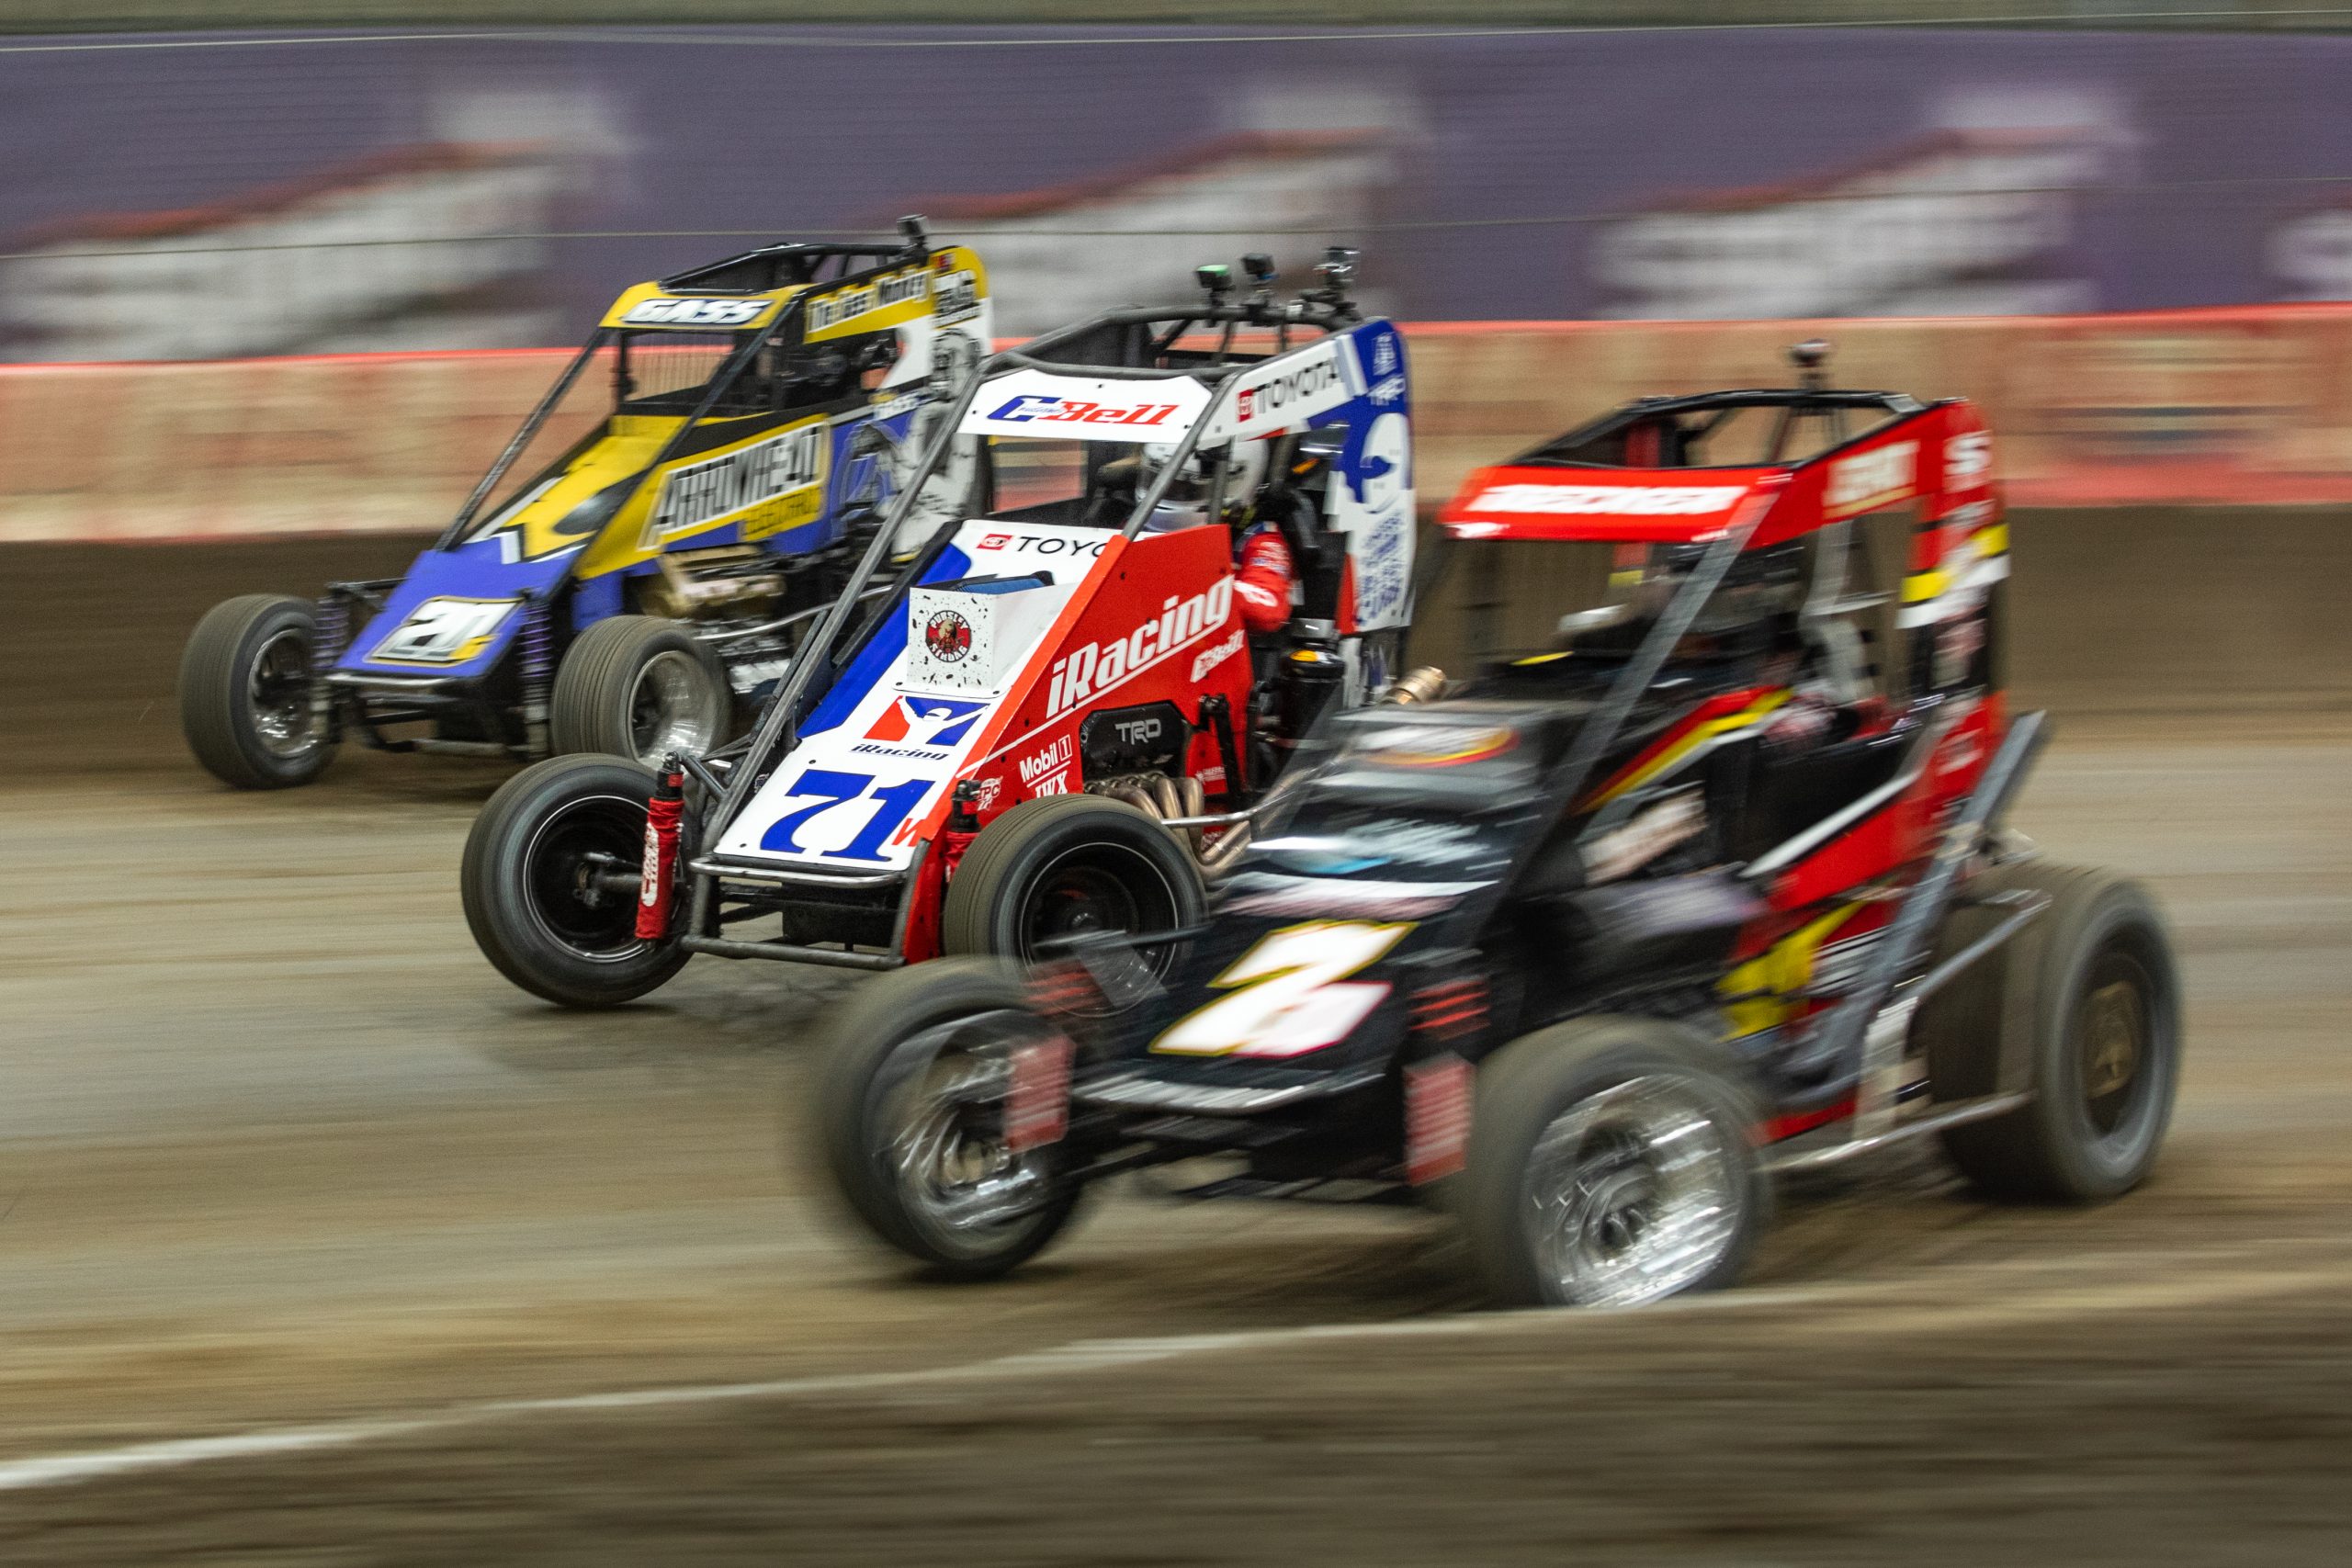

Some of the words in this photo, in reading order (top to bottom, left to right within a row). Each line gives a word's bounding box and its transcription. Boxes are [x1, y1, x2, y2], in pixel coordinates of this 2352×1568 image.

[621, 299, 774, 323] GASS
[1046, 574, 1236, 719] iRacing
[1114, 718, 1161, 745] TRD
[850, 743, 949, 761] iRacing
[1019, 742, 1058, 784] Mobil
